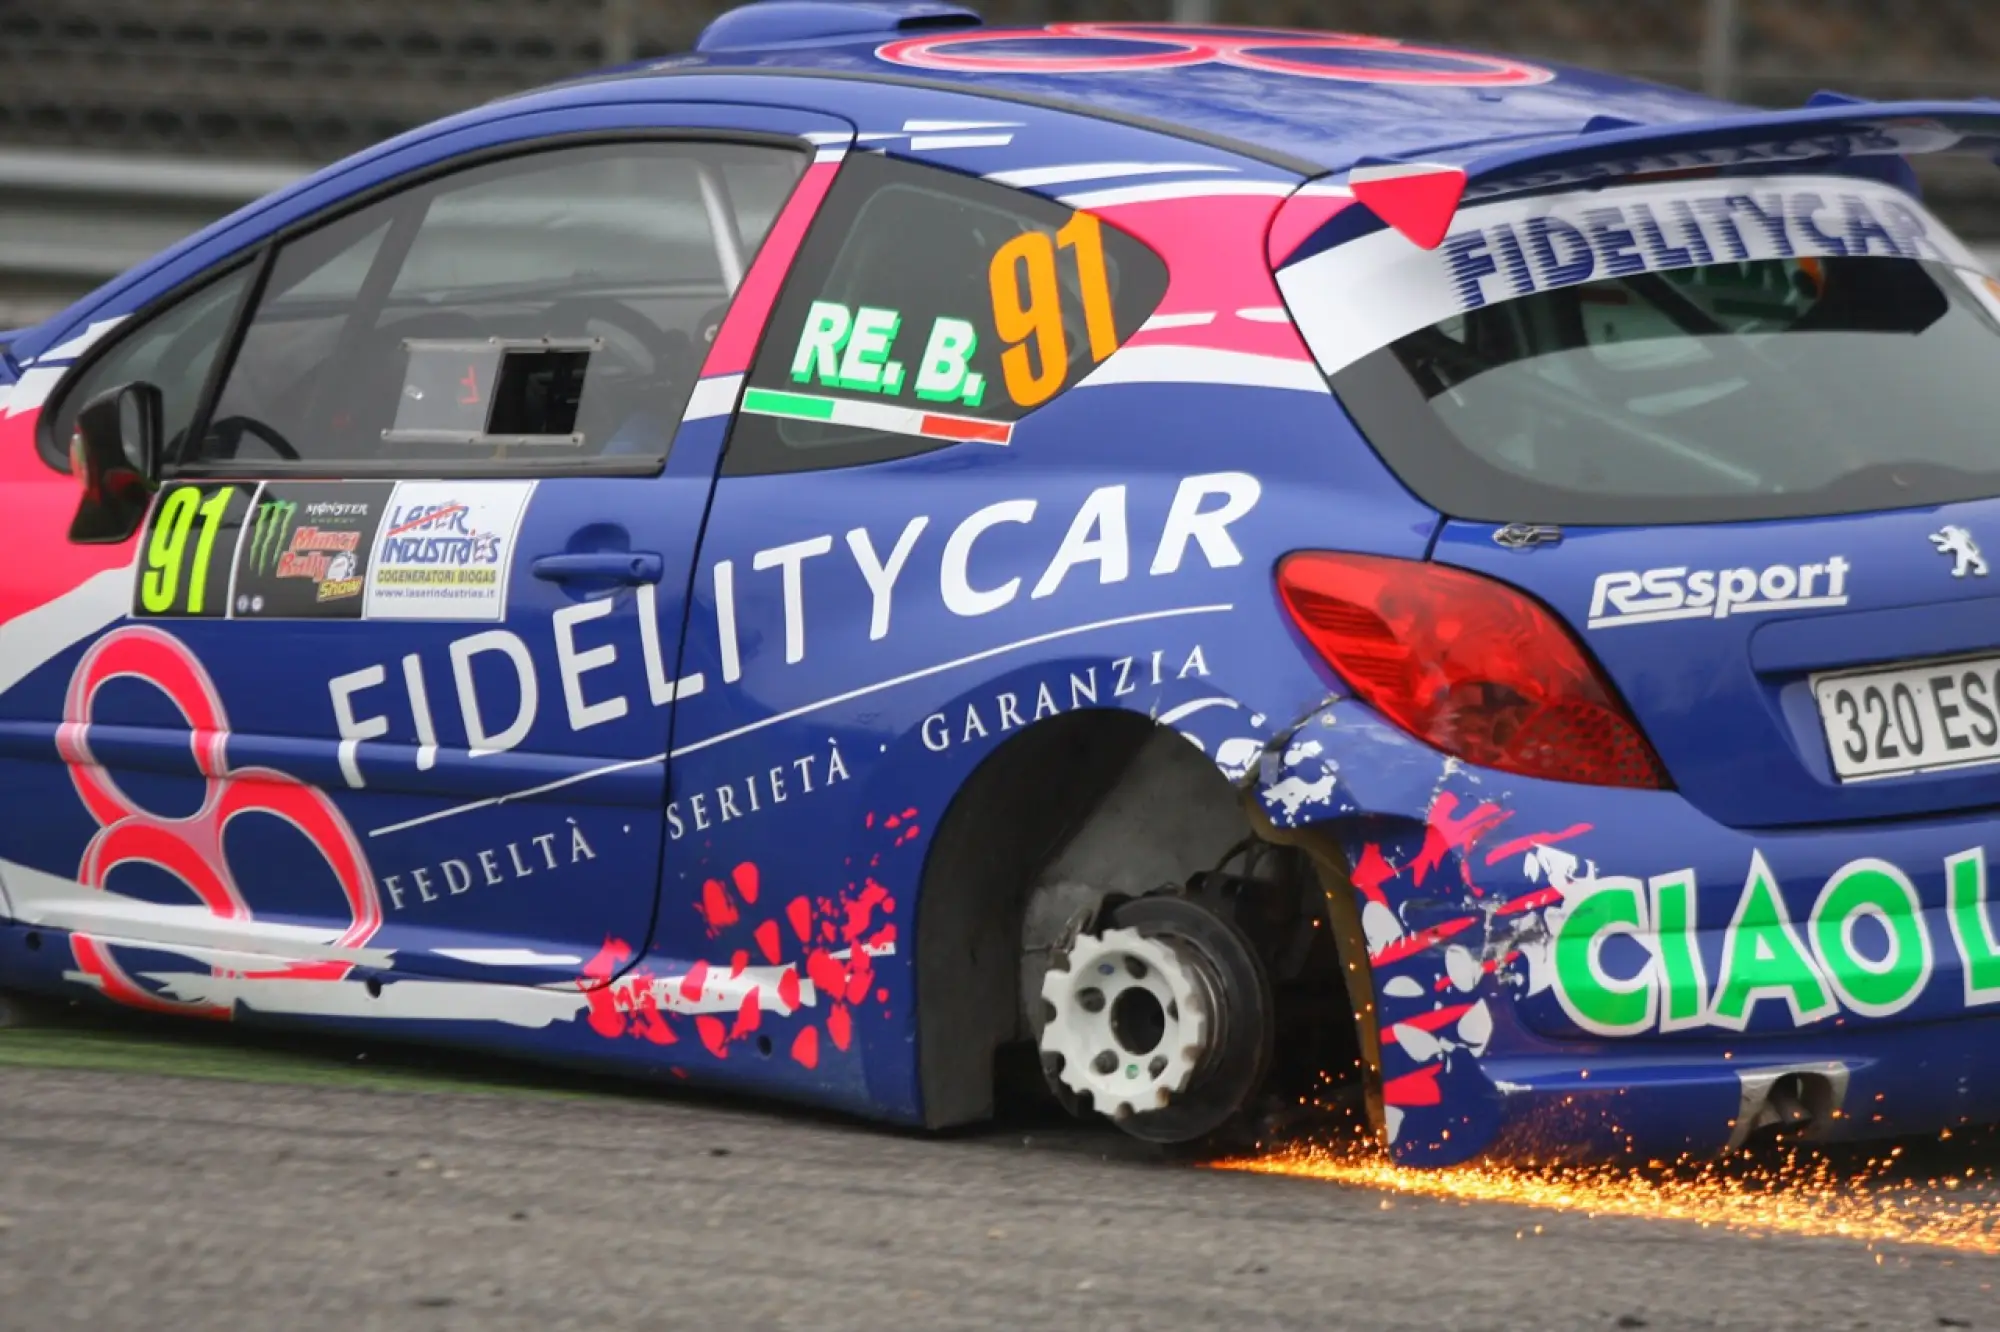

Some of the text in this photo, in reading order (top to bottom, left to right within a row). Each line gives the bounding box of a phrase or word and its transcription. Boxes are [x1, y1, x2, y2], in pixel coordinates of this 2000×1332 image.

[1442, 190, 1932, 310] FIDELITYCAR
[988, 209, 1118, 408] 91
[790, 300, 985, 406] RE. B.
[141, 485, 235, 613] 91
[306, 502, 369, 516] MONSTER
[387, 500, 470, 535] LASER
[276, 551, 333, 583] Rally
[317, 576, 363, 603] Show
[377, 569, 496, 584] COGENERATORI BIOGAS
[380, 534, 501, 566] INDUSTRIES
[1588, 556, 1850, 622] RSsport
[328, 471, 1263, 788] FIDELITYCAR
[375, 587, 495, 599] www.laserindustries.it
[1834, 668, 2000, 764] 320 ES
[385, 645, 1211, 909] FEDELTÀ SERIETÀ GARANZIA
[1553, 847, 1932, 1037] CIAO
